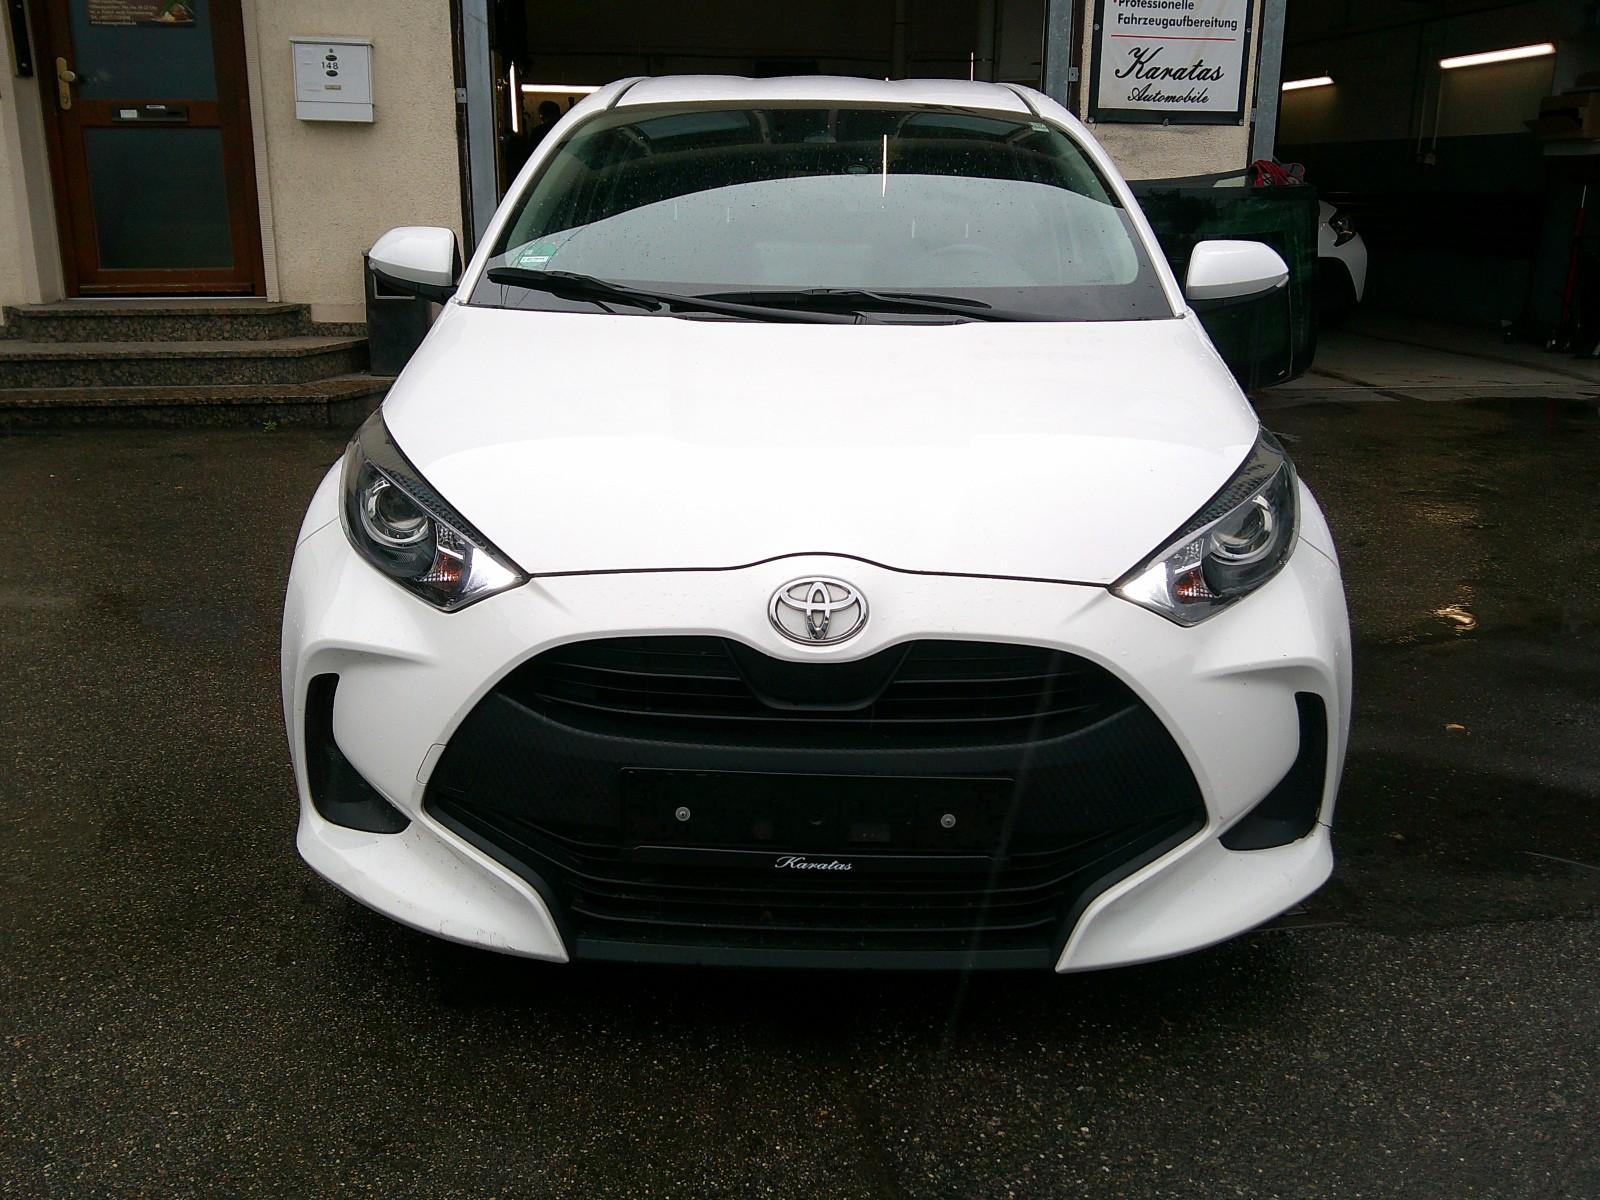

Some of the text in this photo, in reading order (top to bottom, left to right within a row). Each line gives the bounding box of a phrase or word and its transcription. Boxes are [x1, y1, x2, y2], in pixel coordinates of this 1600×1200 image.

[1118, 0, 1195, 10] Professionelle
[1117, 13, 1238, 31] Fahrzeugaufbereitung
[321, 61, 339, 70] 148
[1114, 46, 1225, 81] Karatas
[1127, 83, 1209, 103] Automobile
[774, 856, 852, 871] Karatas
